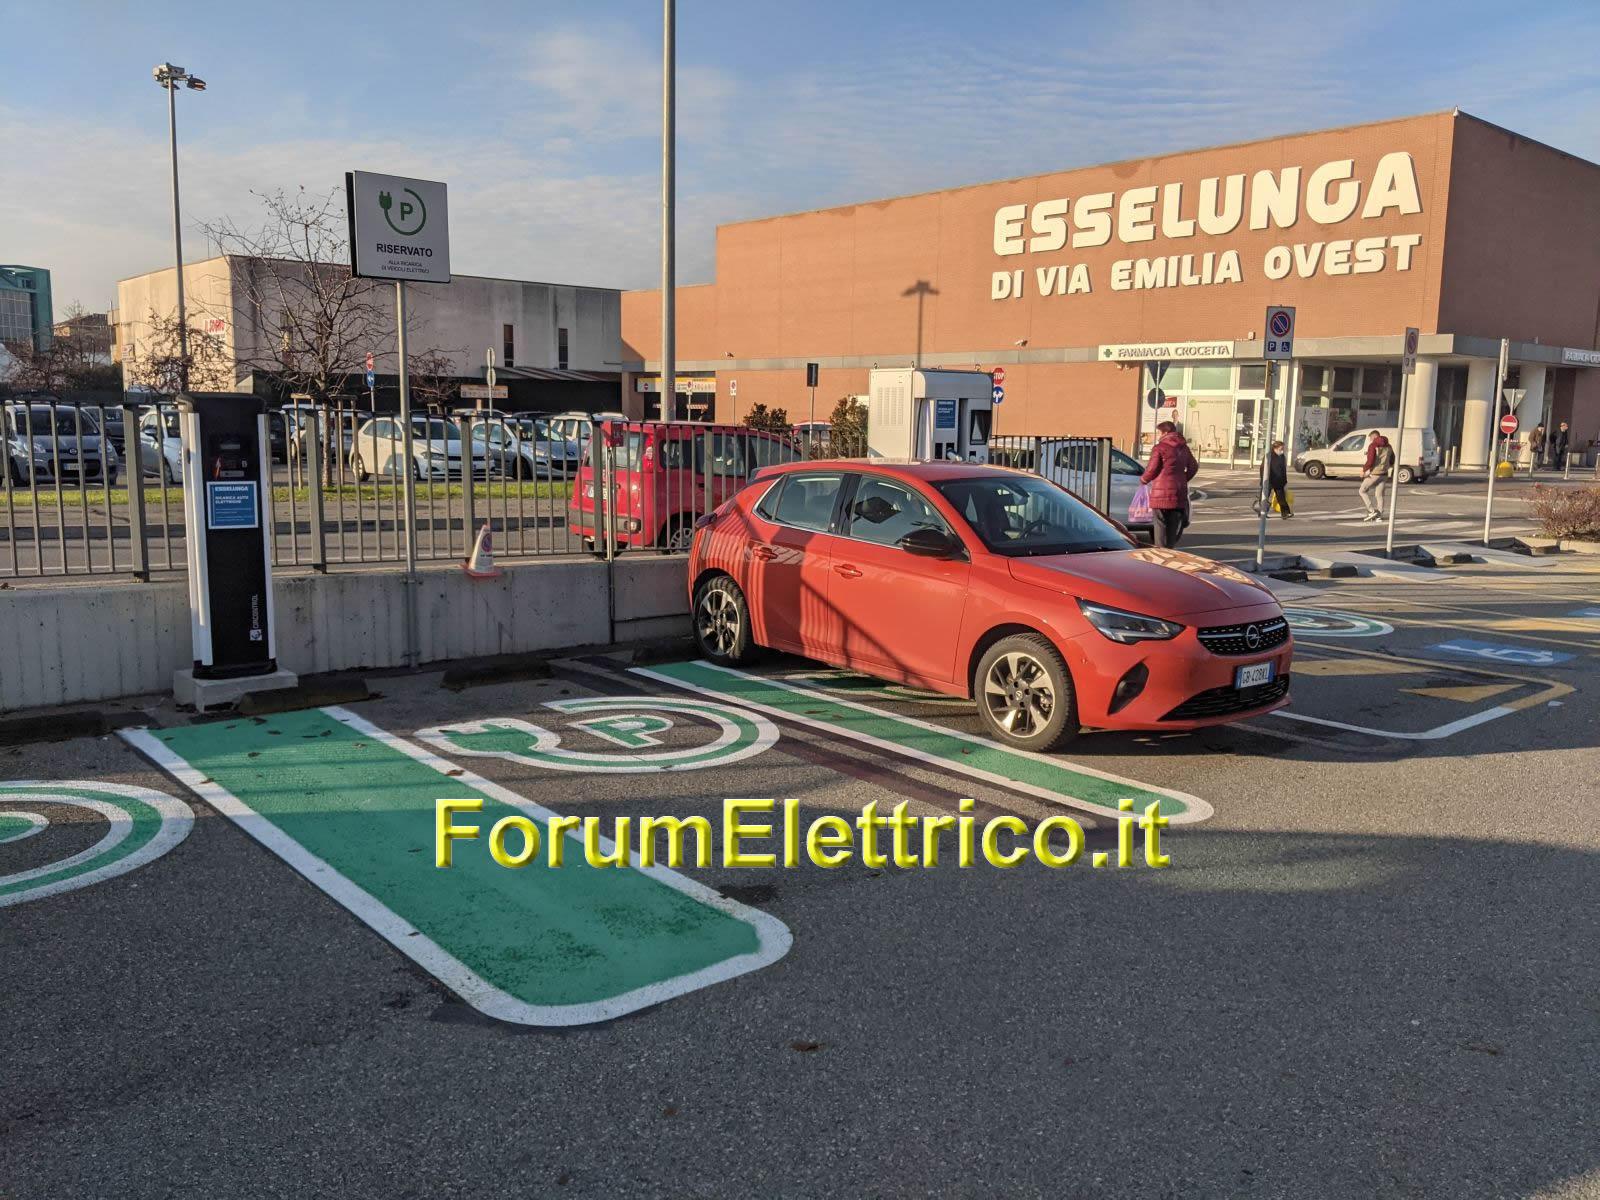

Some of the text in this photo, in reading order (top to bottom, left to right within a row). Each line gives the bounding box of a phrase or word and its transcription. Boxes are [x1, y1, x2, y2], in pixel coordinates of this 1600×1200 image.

[400, 202, 413, 221] P
[993, 151, 1422, 257] ESSELUNGA
[376, 243, 433, 258] RISERVATO
[991, 234, 1422, 300] DI VIA EMILIA OVEST
[1118, 345, 1230, 358] FARMACIA CROCETTA
[567, 714, 675, 749] P
